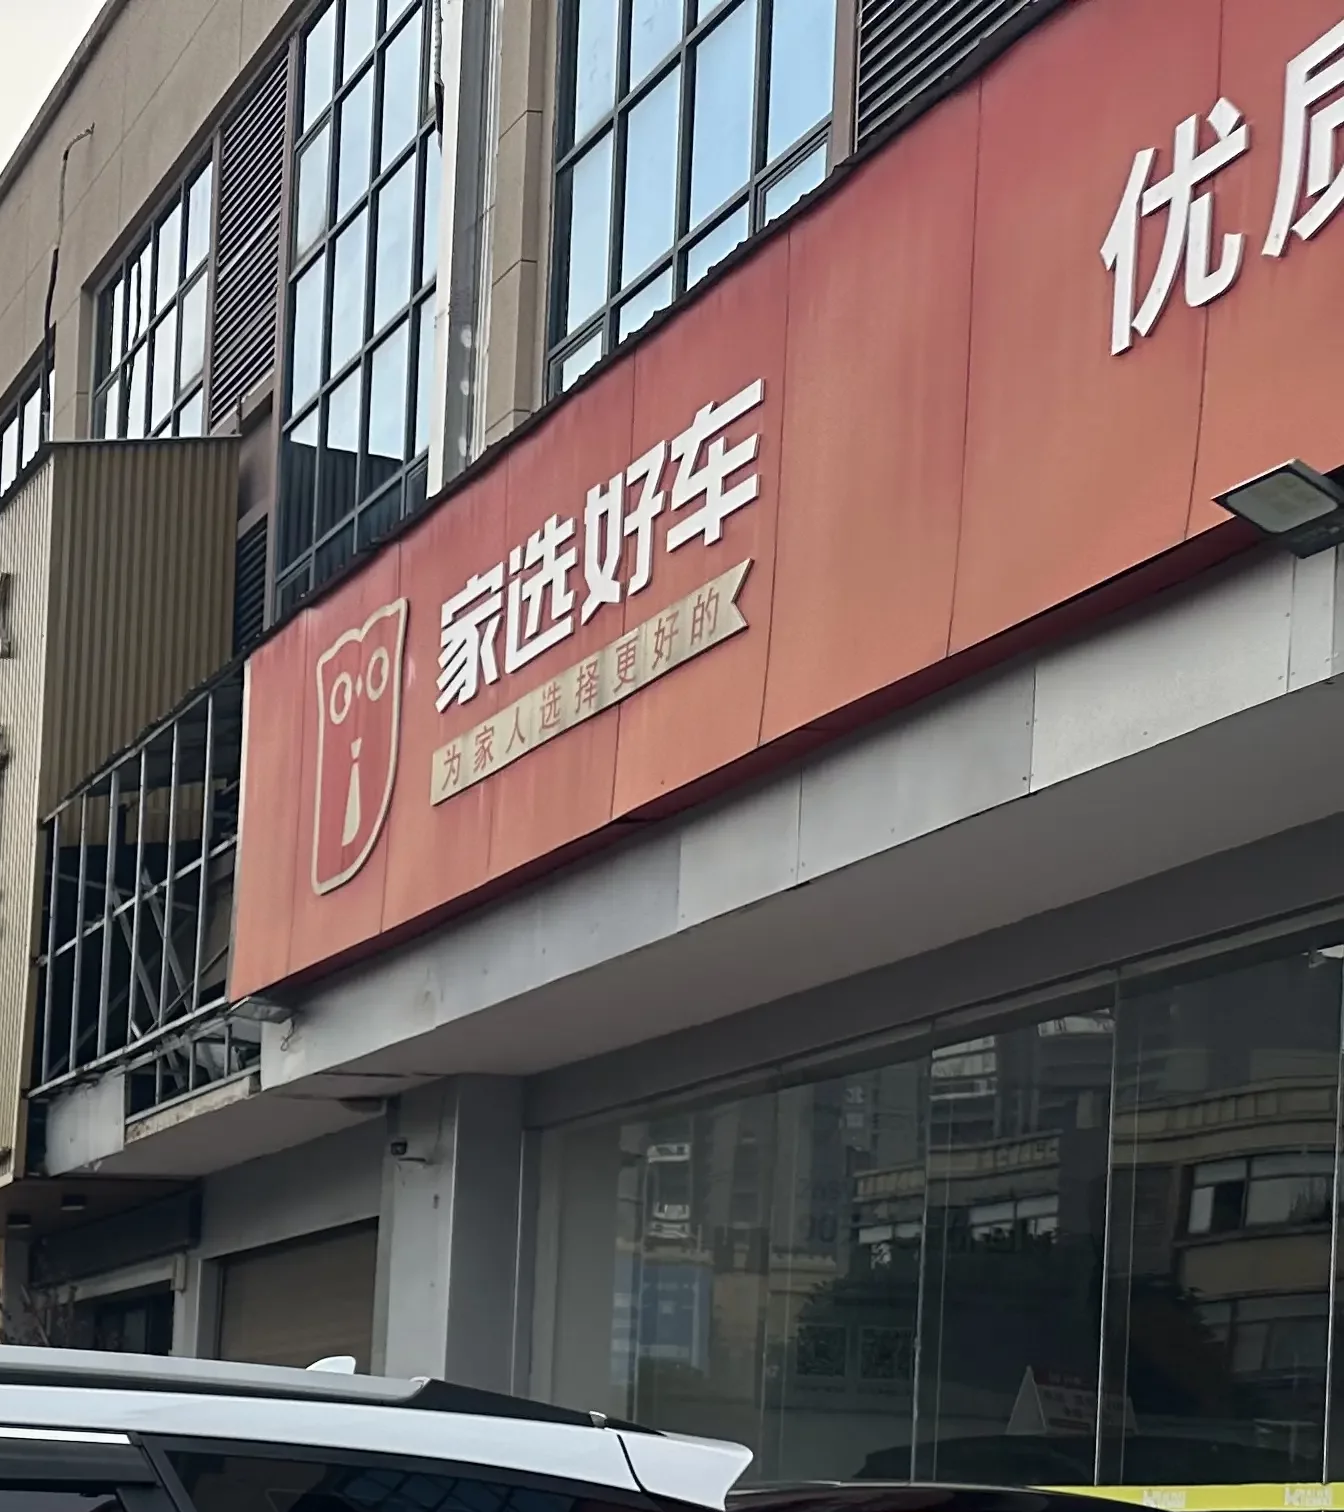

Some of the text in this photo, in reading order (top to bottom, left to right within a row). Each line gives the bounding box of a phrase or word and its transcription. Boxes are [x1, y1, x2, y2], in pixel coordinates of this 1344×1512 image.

[434, 377, 765, 713] 家选好车
[440, 586, 719, 792] 为家人选择更好的
